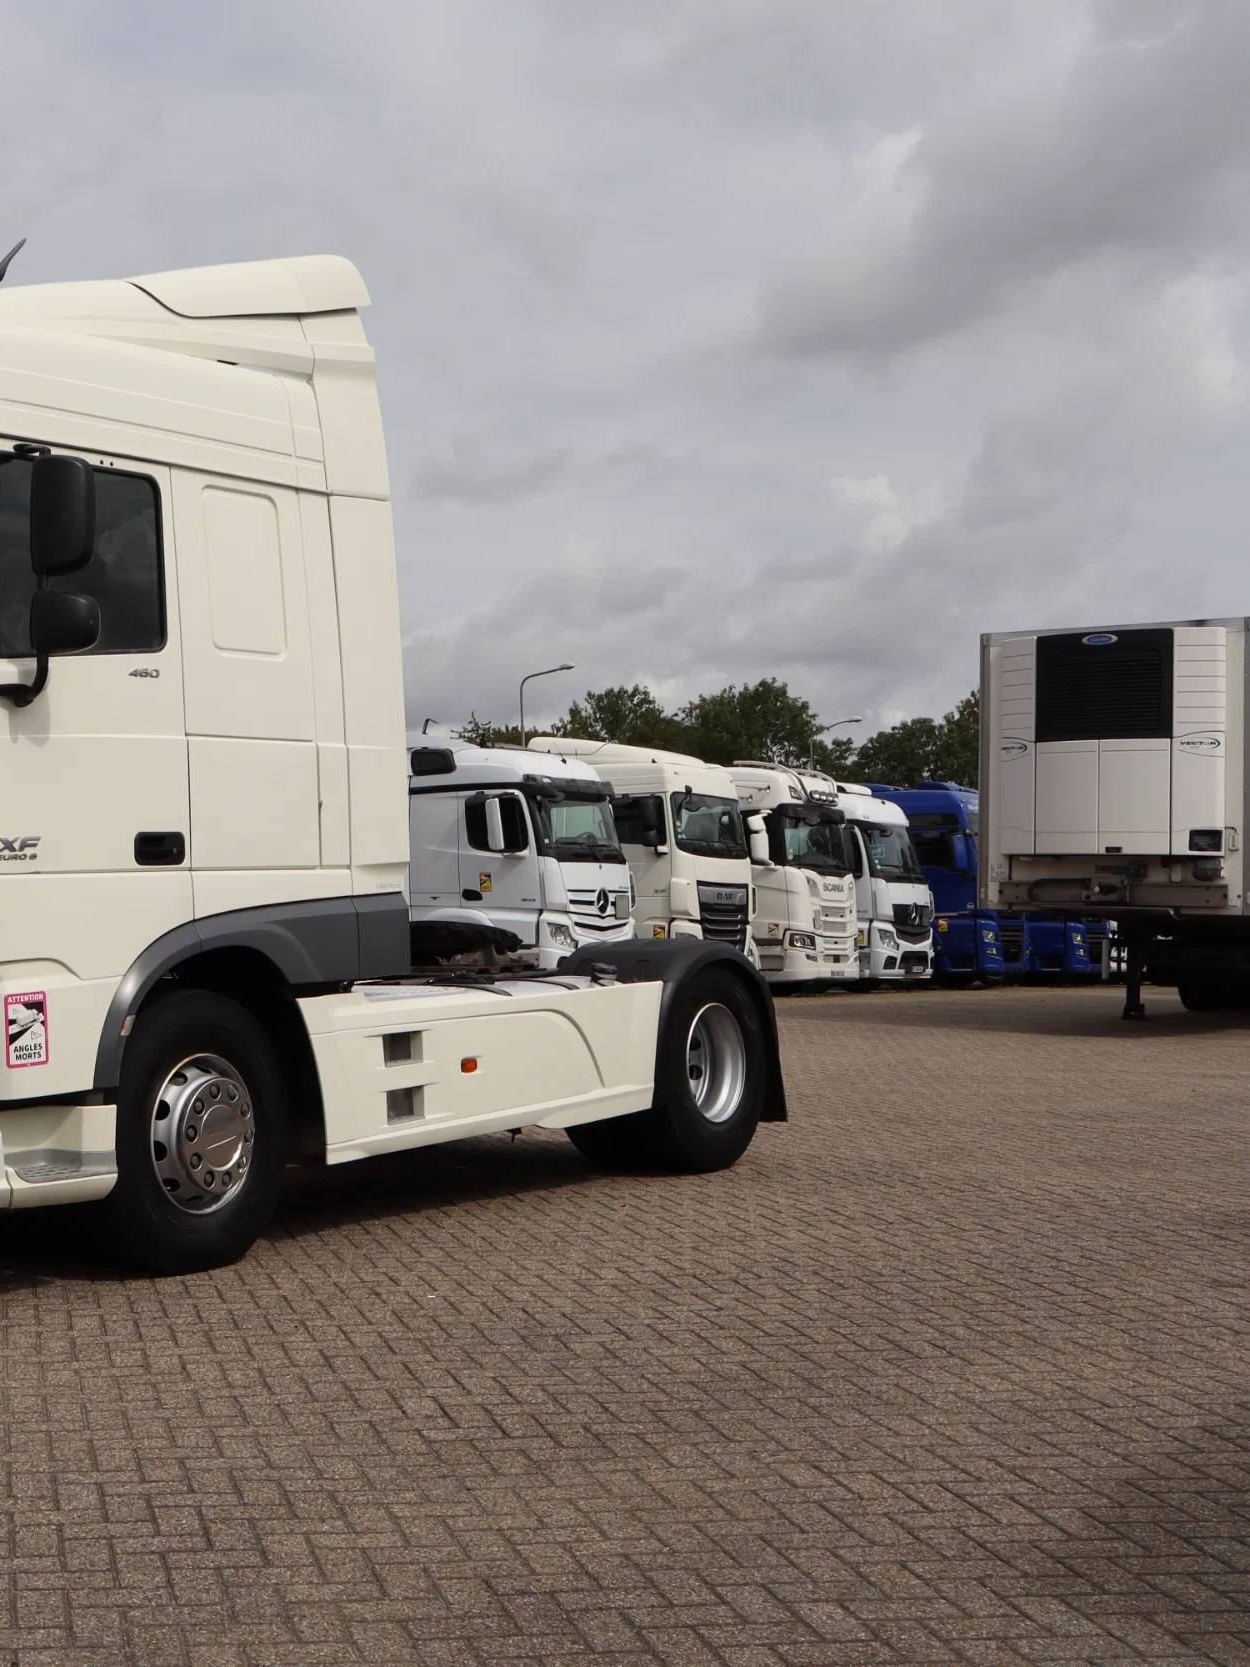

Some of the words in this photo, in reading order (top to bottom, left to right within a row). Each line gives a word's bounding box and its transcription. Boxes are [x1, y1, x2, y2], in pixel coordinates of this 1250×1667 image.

[128, 668, 160, 678] 460
[823, 882, 845, 893] SCANIA
[716, 892, 734, 900] DAF
[7, 993, 44, 1003] ATTENTION
[13, 1043, 43, 1053] ANGLES
[15, 1051, 42, 1061] MORTS
